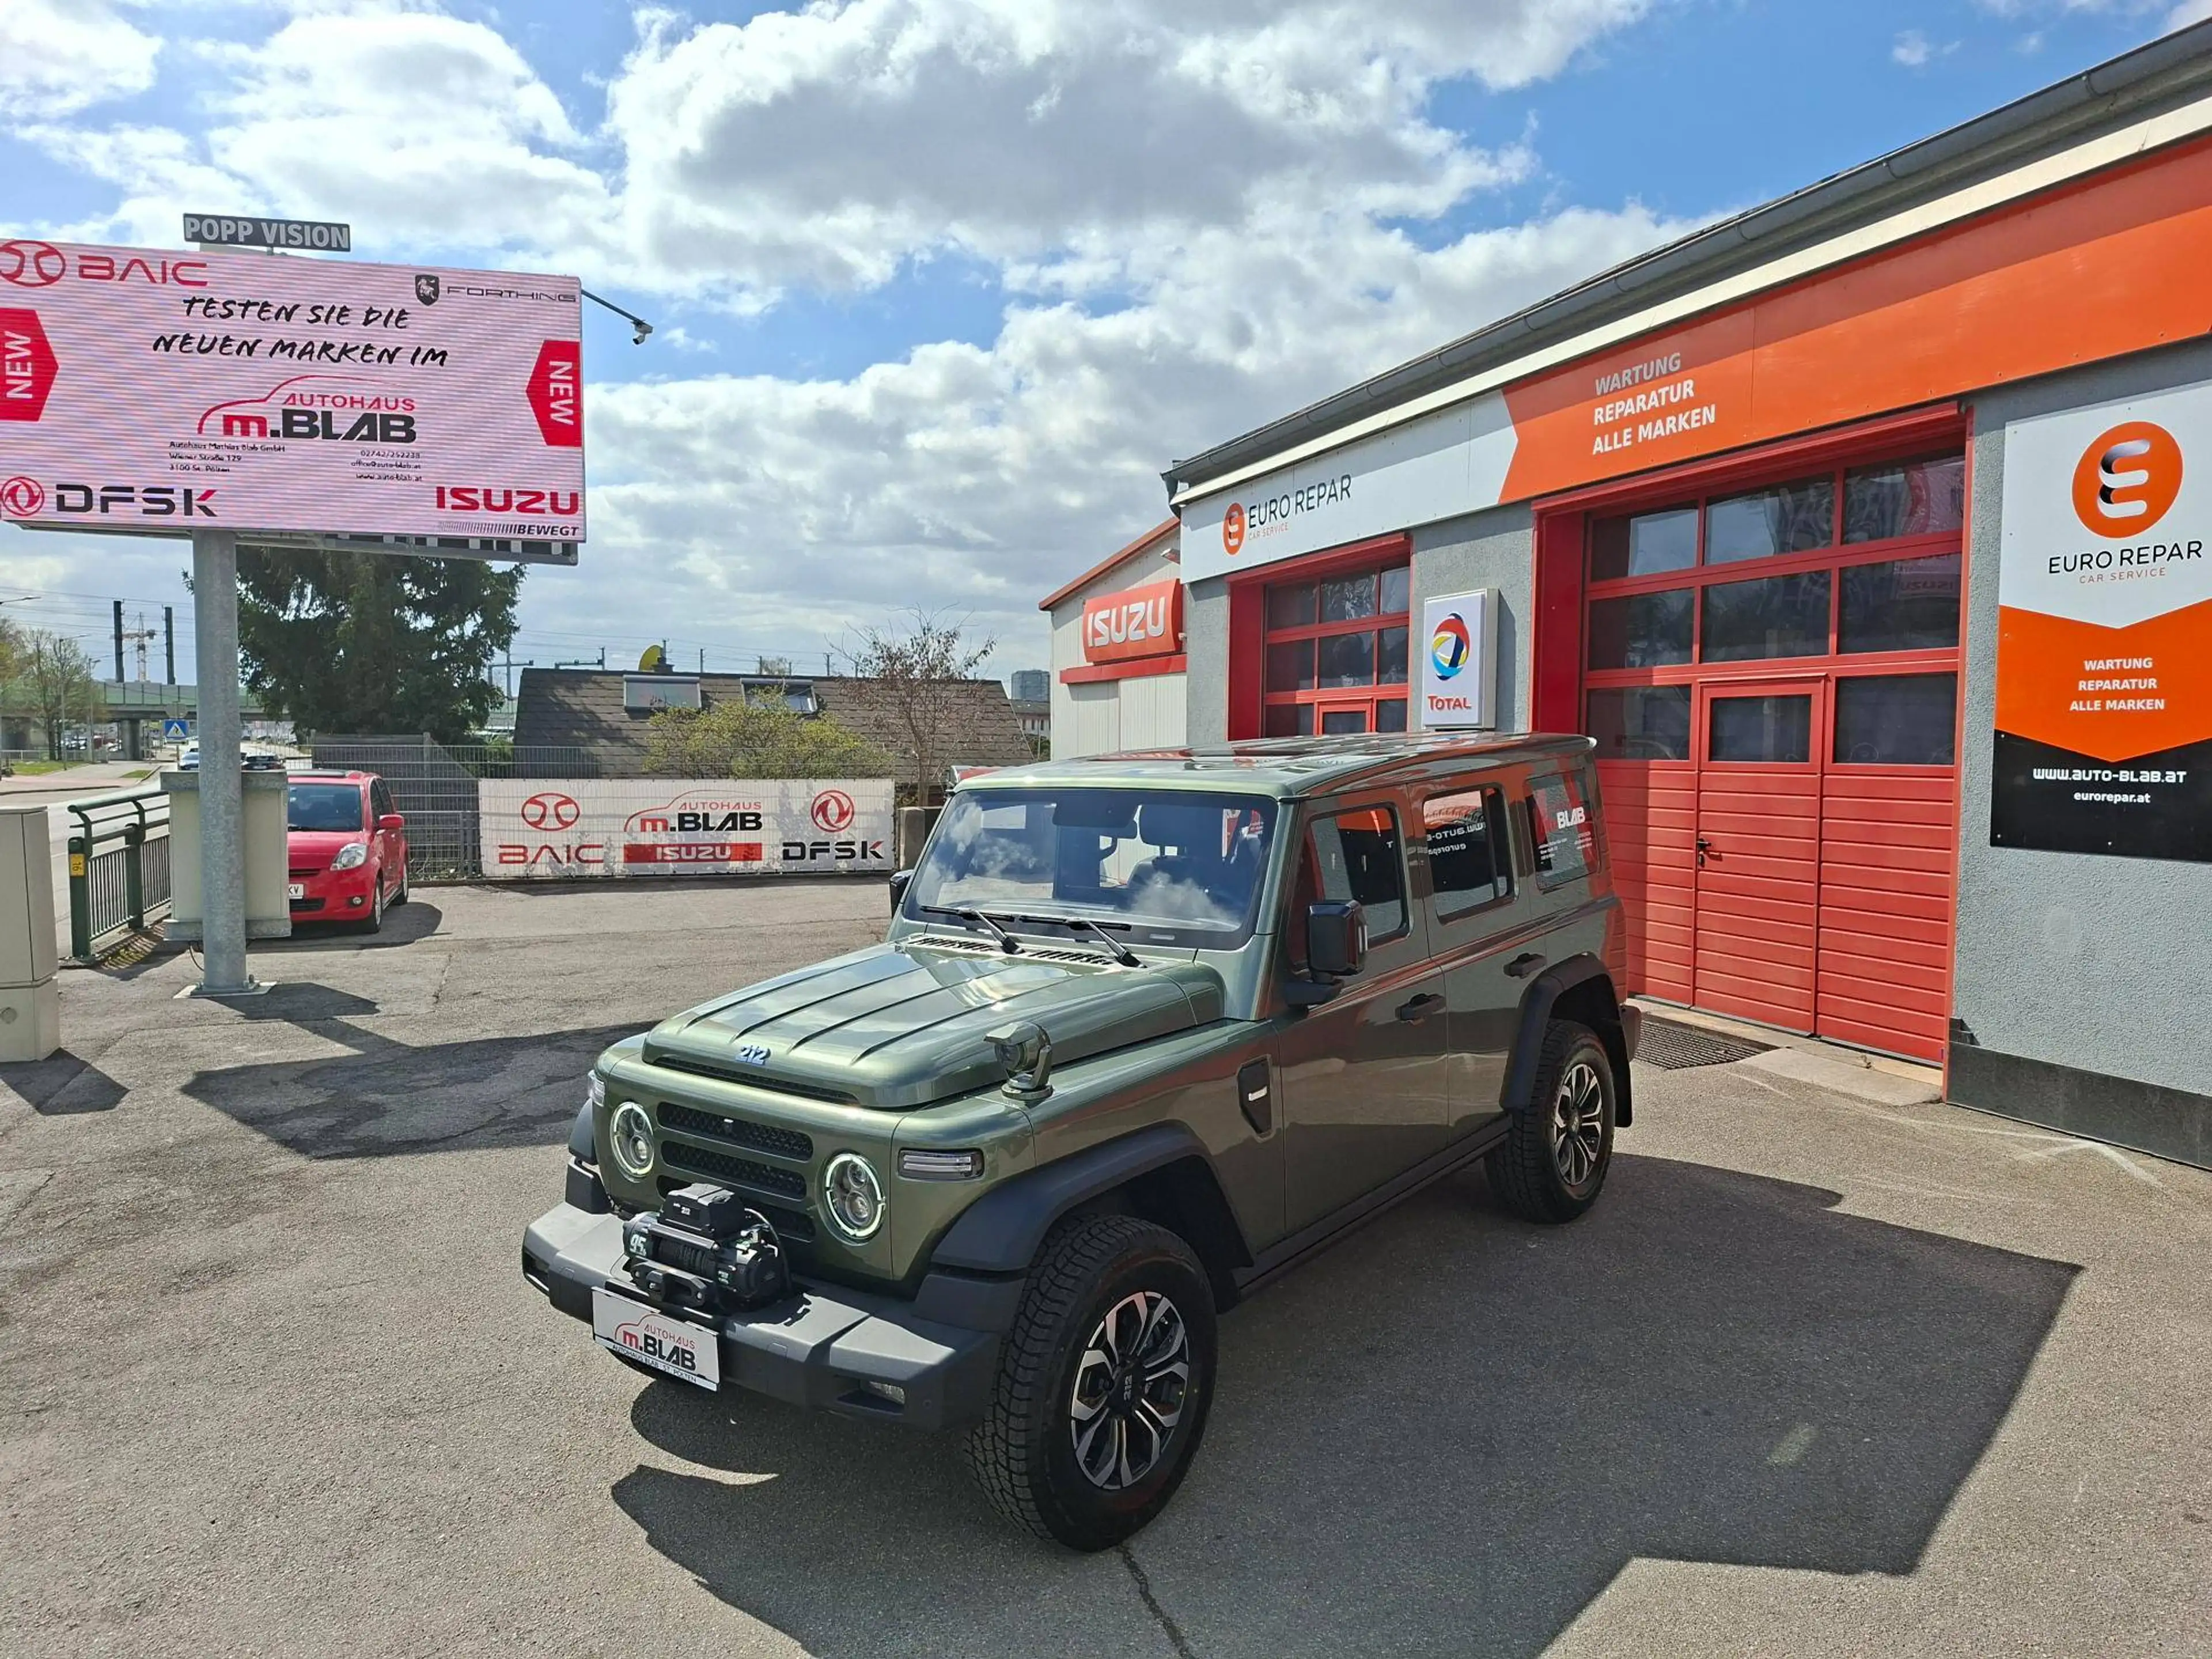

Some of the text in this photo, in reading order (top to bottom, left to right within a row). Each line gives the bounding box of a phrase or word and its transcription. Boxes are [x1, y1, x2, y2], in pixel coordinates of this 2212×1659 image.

[185, 218, 349, 248] POPP VISION
[78, 255, 207, 286] BAIC
[447, 286, 575, 301] FORTHING
[183, 296, 410, 328] TESTEN SIE DIE
[153, 333, 448, 367] NEUEN MARKEN IM
[5, 331, 32, 399] NEW
[1596, 353, 1680, 396] WARTUNG
[282, 393, 415, 411] AUTOHAUS
[549, 361, 574, 425] NEW
[1594, 379, 1694, 425] REPARATUR
[1593, 404, 1715, 455] ALLE MARKEN
[56, 484, 217, 517] DFSK
[436, 486, 579, 515] ISUZU
[1249, 475, 1351, 528] EURO REPAR
[518, 525, 579, 536] BEWEGT
[1262, 522, 1289, 537] SERVICE
[2049, 540, 2203, 574] EURO REPAR
[2079, 567, 2166, 584] CAR SERVICE
[1088, 597, 1165, 647] ISUZU
[2084, 658, 2153, 671] WARTUNG
[2078, 678, 2157, 691] REPARATUR
[1428, 695, 1471, 710] TOTAL
[2070, 699, 2165, 711] ALLE MARKEN
[679, 801, 762, 810] AUTOHAUS
[2074, 791, 2151, 804] eurorepar.at
[498, 844, 604, 864] BAIC
[656, 845, 730, 860] ISUZU
[783, 840, 884, 861] DFSK
[736, 1046, 771, 1066] 212
[644, 1324, 696, 1350] AUTOHAUS
[623, 1331, 696, 1371] m.BLAB
